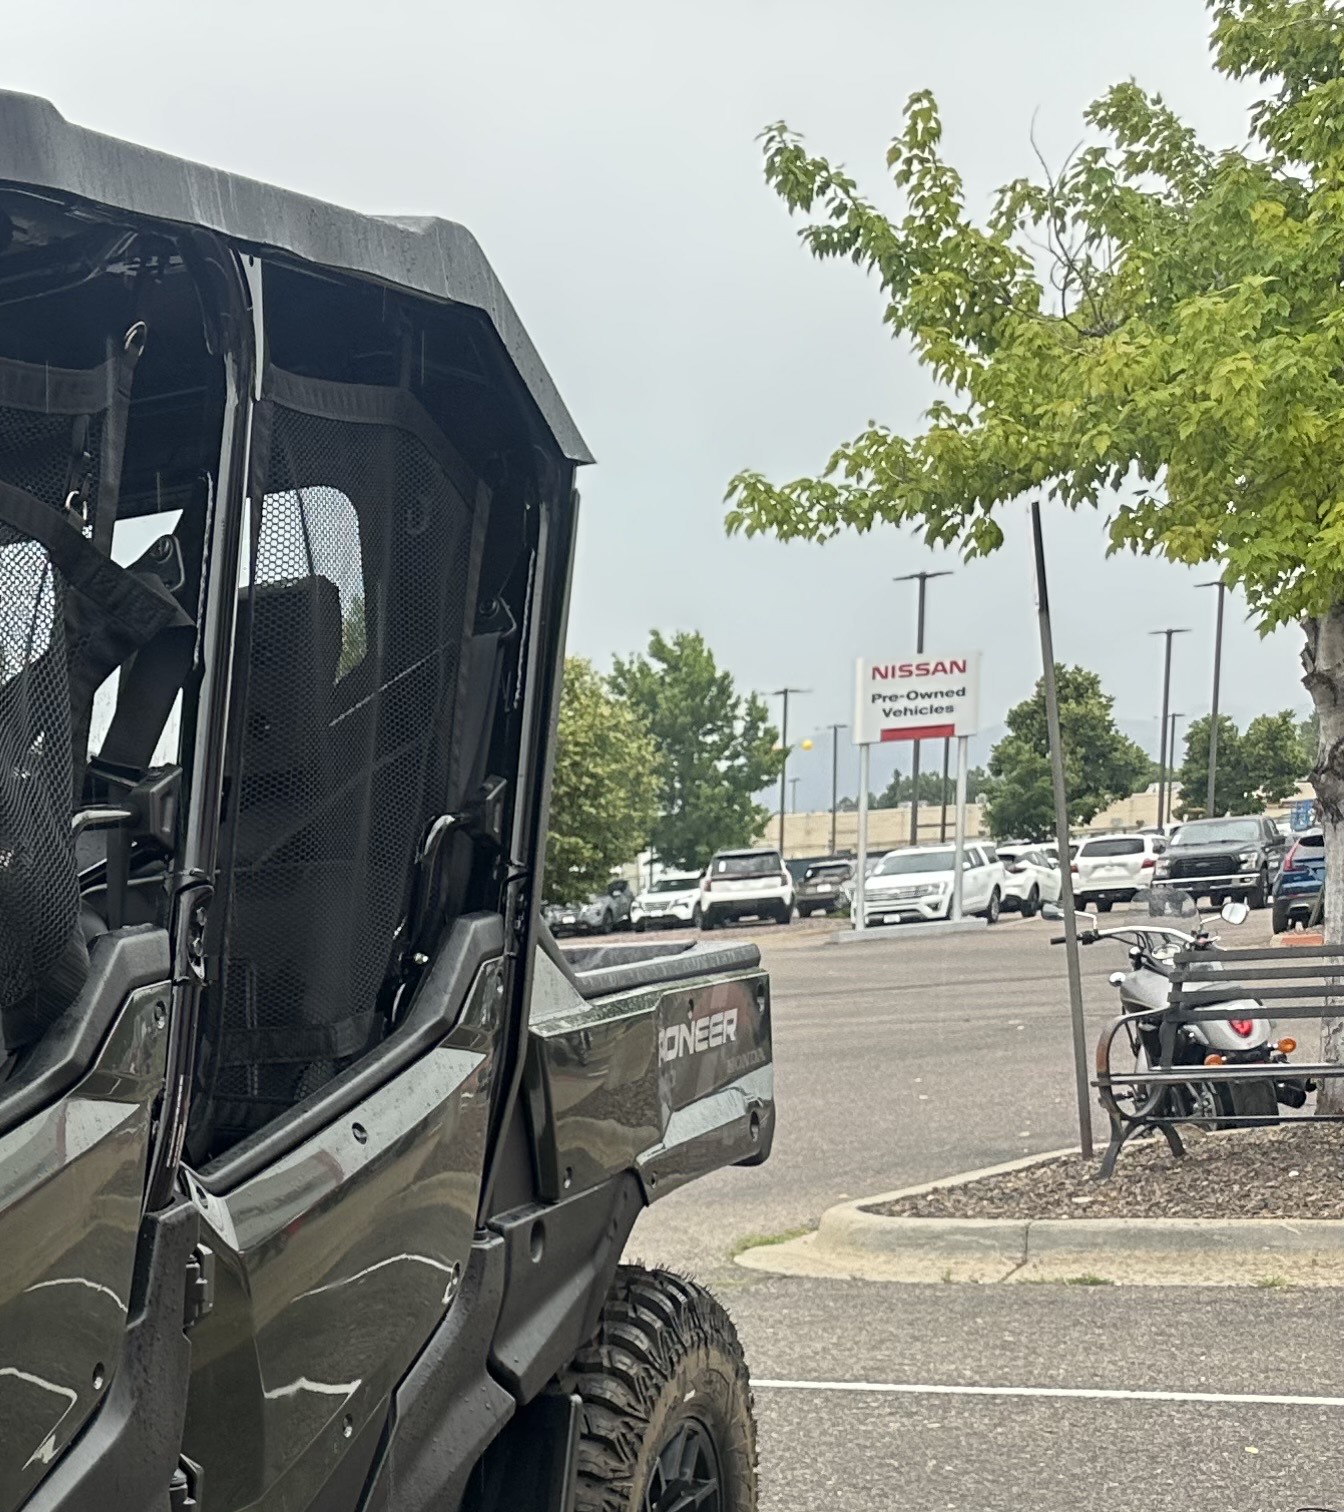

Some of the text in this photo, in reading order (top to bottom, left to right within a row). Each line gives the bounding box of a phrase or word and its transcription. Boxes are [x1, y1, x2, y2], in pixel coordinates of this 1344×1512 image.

[872, 659, 967, 680] NISSAN
[871, 687, 966, 703] Pre-Owned
[882, 704, 954, 718] Vehicles
